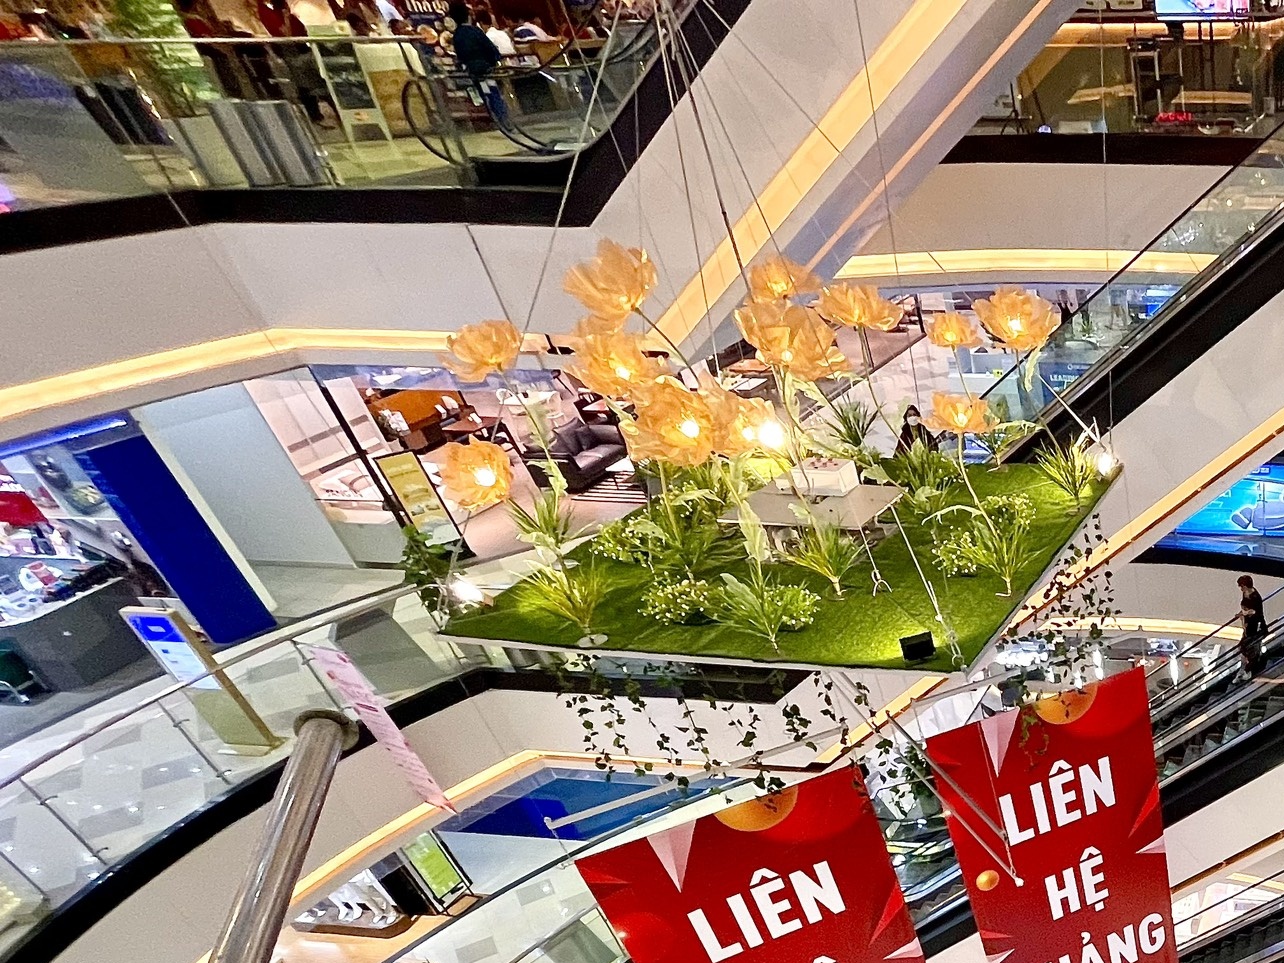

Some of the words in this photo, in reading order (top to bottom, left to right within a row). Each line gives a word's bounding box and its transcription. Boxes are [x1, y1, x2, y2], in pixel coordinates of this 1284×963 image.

[999, 756, 1116, 846] LIÊN
[688, 861, 846, 963] LIÊN
[1045, 846, 1109, 921] HỆ
